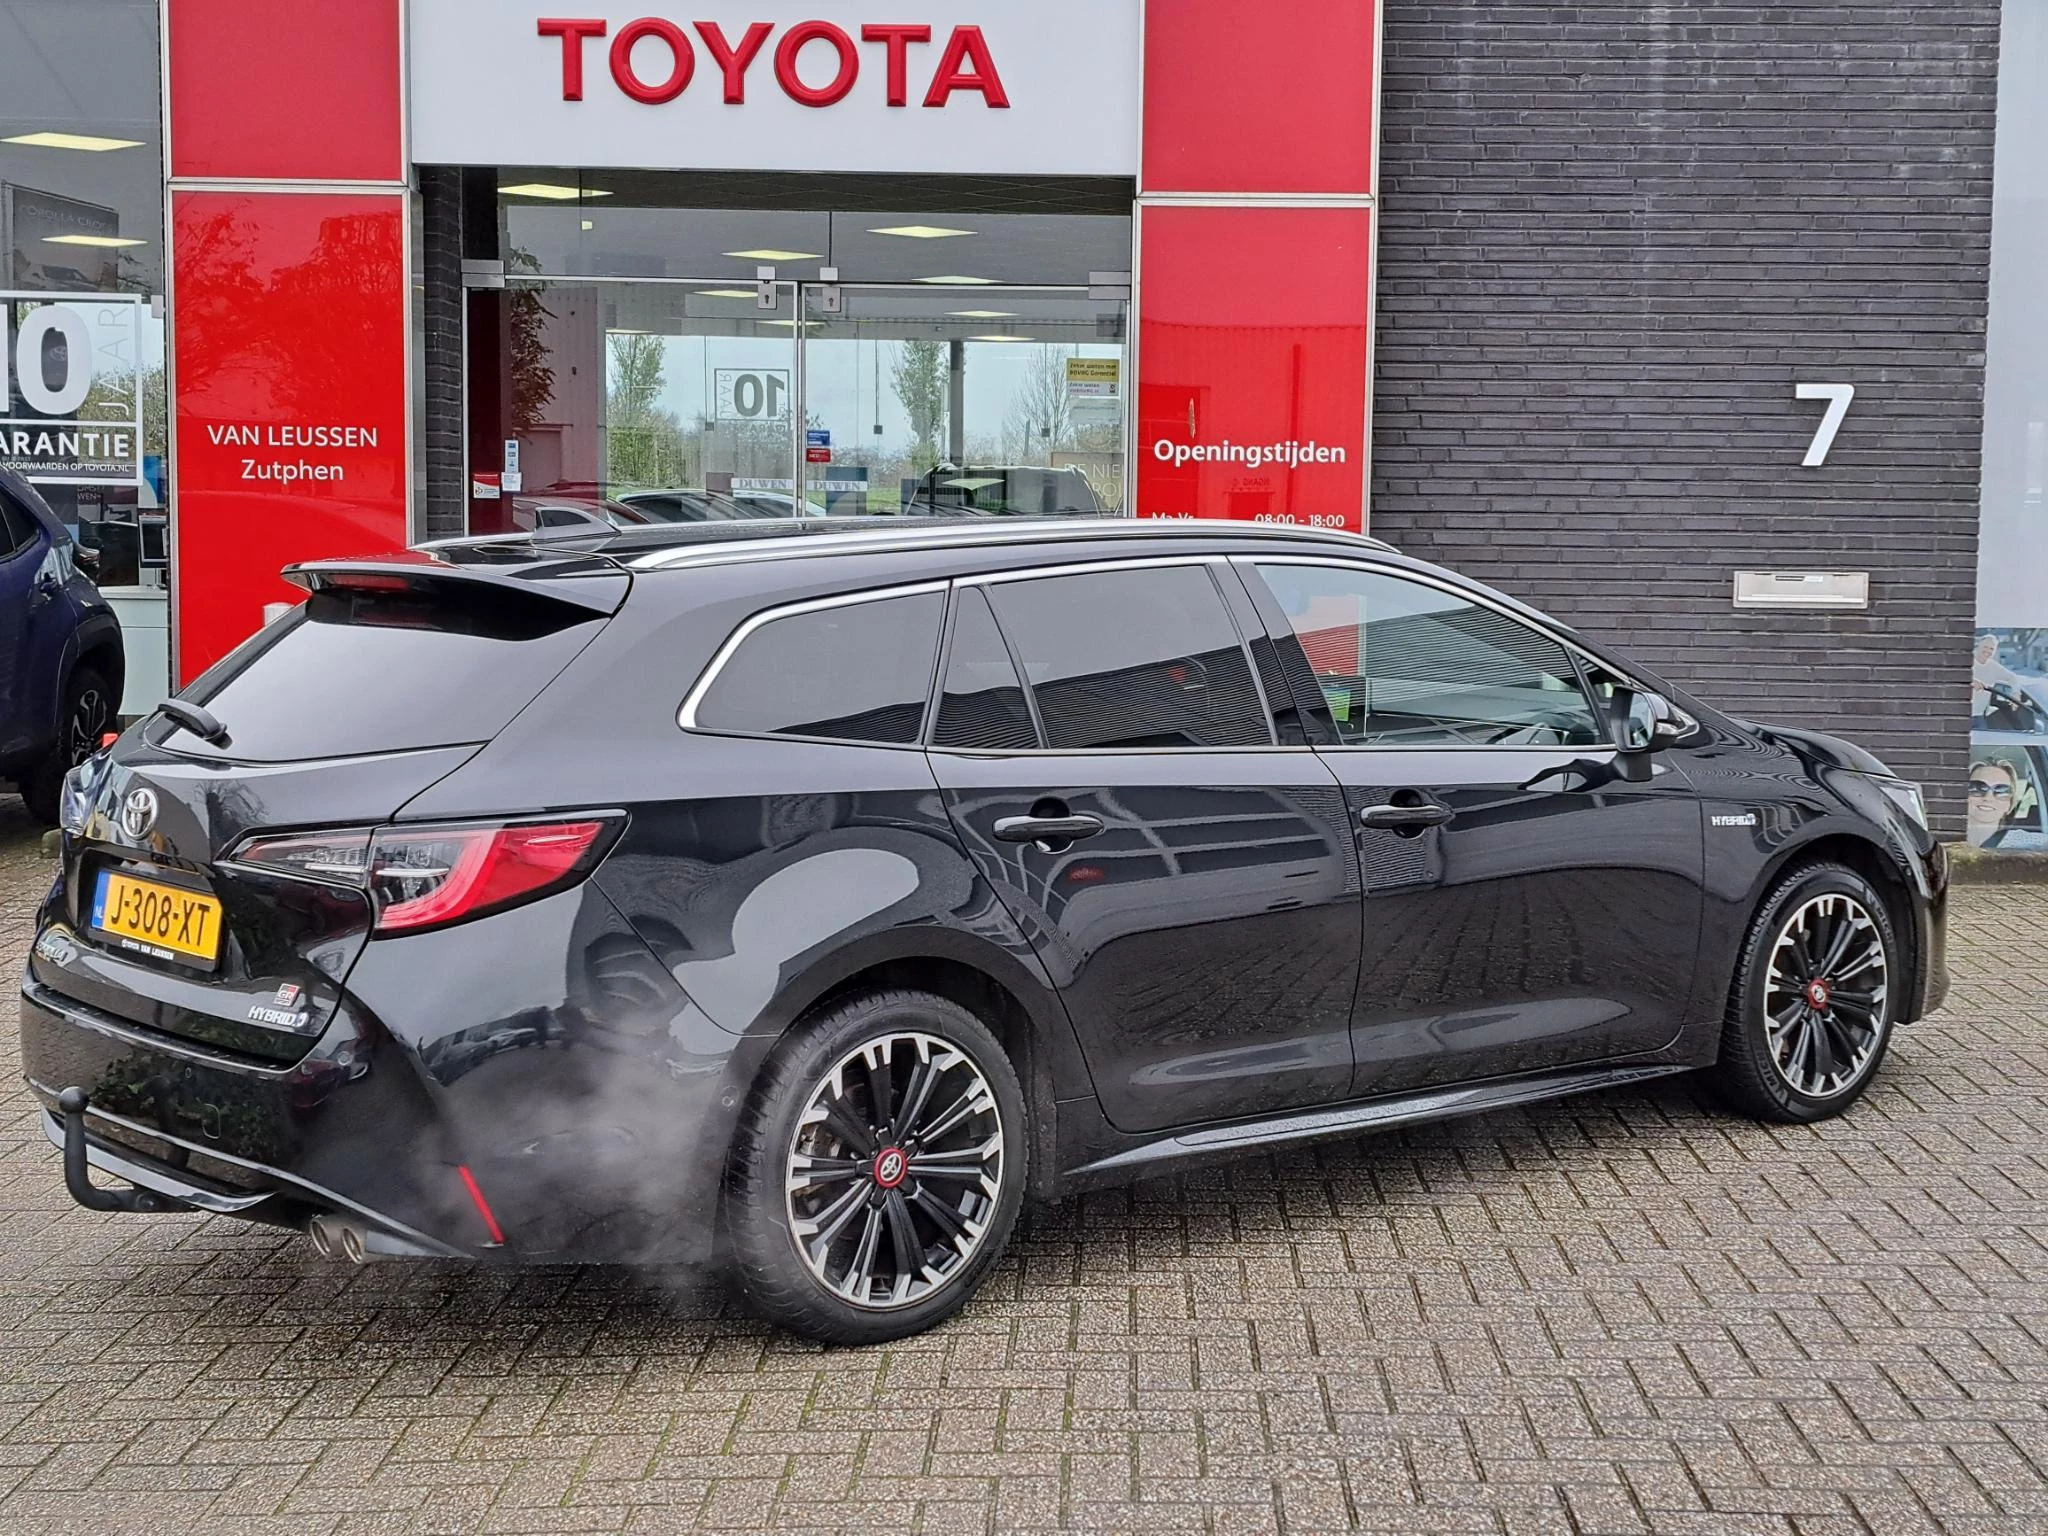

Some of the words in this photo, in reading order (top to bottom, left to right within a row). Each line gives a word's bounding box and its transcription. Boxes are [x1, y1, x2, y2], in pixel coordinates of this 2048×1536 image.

[537, 17, 1011, 109] TOYOTA
[0, 303, 92, 416] 0
[97, 306, 130, 416] JAAR
[208, 425, 260, 446] VAN
[268, 426, 378, 447] LEUSSEN
[1796, 383, 1855, 466] 7
[1153, 439, 1346, 468] Openingstijden
[70, 463, 83, 472] OP
[84, 463, 130, 473] TOYOTA.NL
[242, 459, 344, 485] Zutphen
[739, 478, 787, 489] DUWEN
[814, 481, 861, 491] DUWEN
[1308, 514, 1345, 527] 18:00
[1711, 816, 1748, 826] HYBRID
[111, 885, 211, 947] J-308-XT
[247, 1005, 297, 1026] HYBRID
